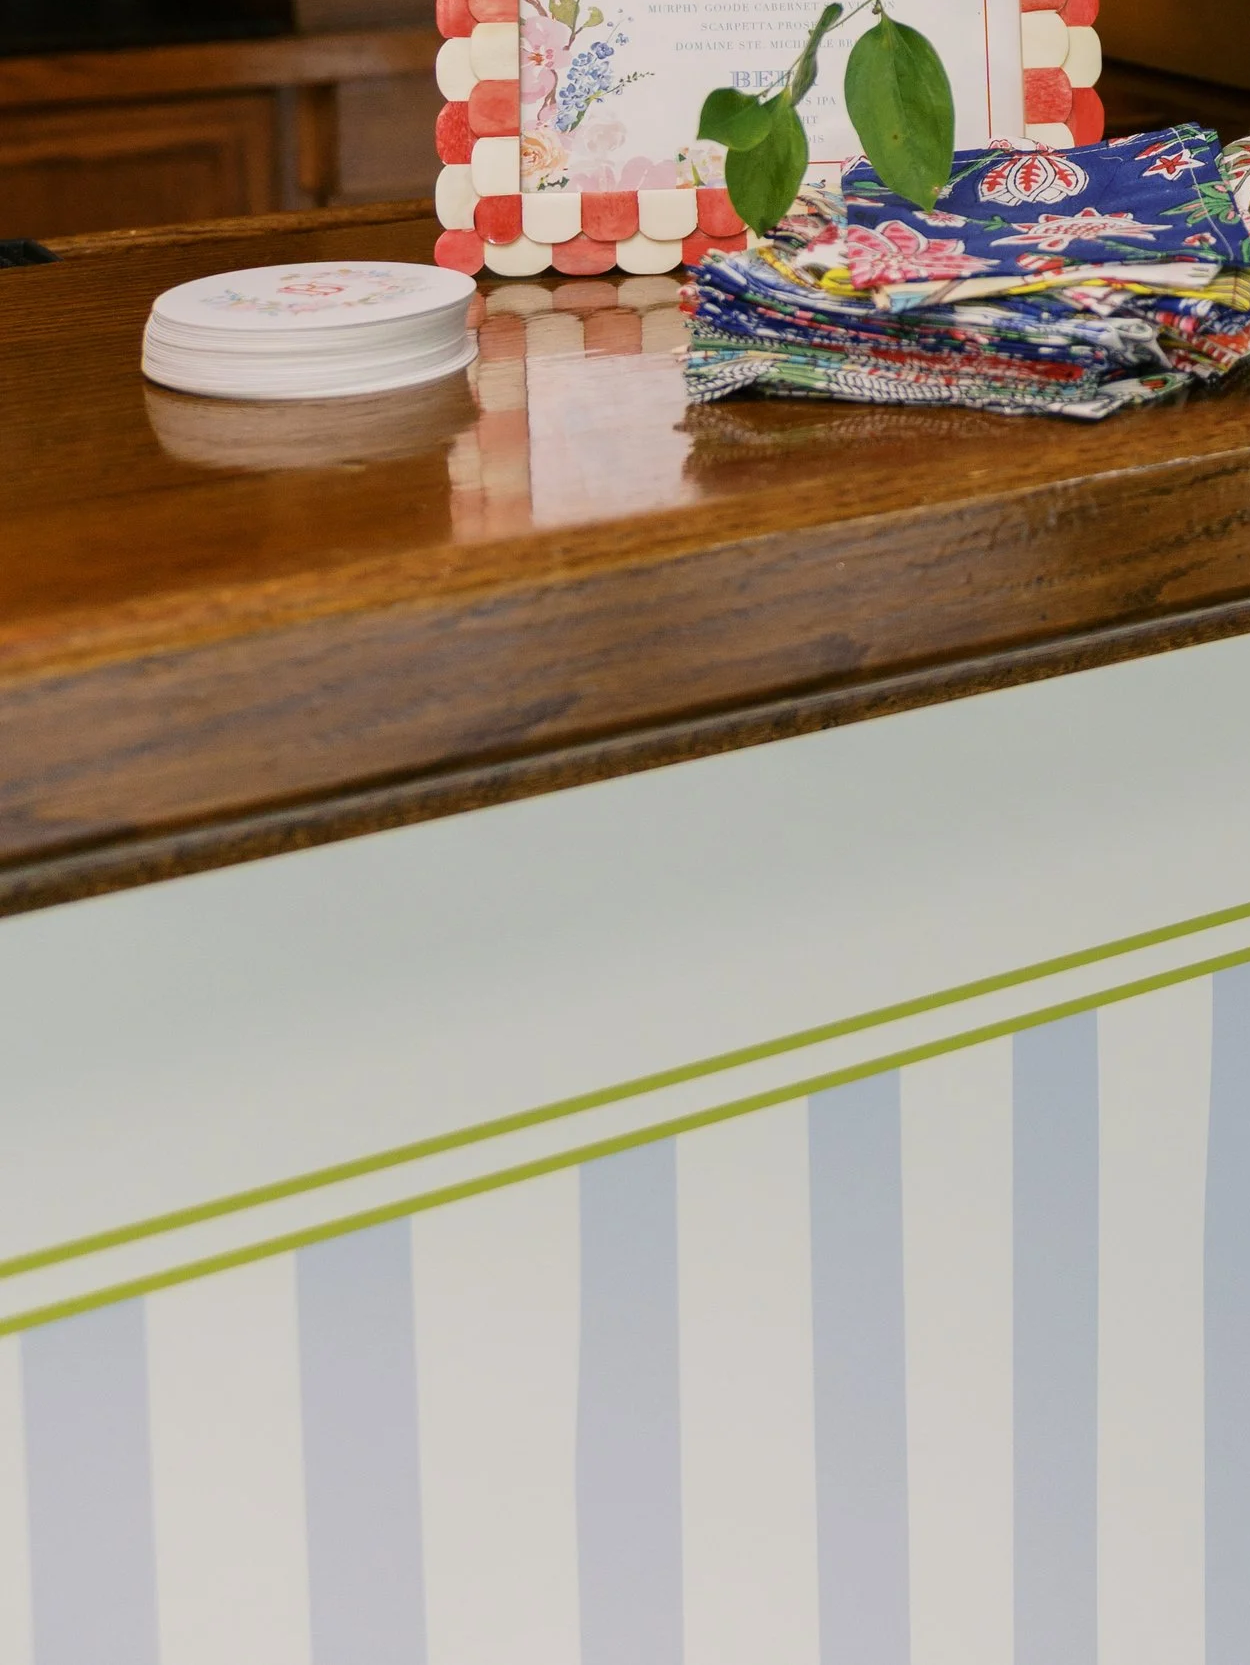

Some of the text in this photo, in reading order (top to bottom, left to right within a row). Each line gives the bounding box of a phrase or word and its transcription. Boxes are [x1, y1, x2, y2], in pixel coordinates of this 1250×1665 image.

[648, 3, 699, 13] MURPHY
[704, 3, 750, 13] GOODE
[754, 2, 818, 12] CABERNET
[700, 21, 773, 32] SCARPETTA
[674, 40, 734, 52] DOMAINE
[730, 70, 819, 88] BEE
[816, 96, 837, 106] IPA
